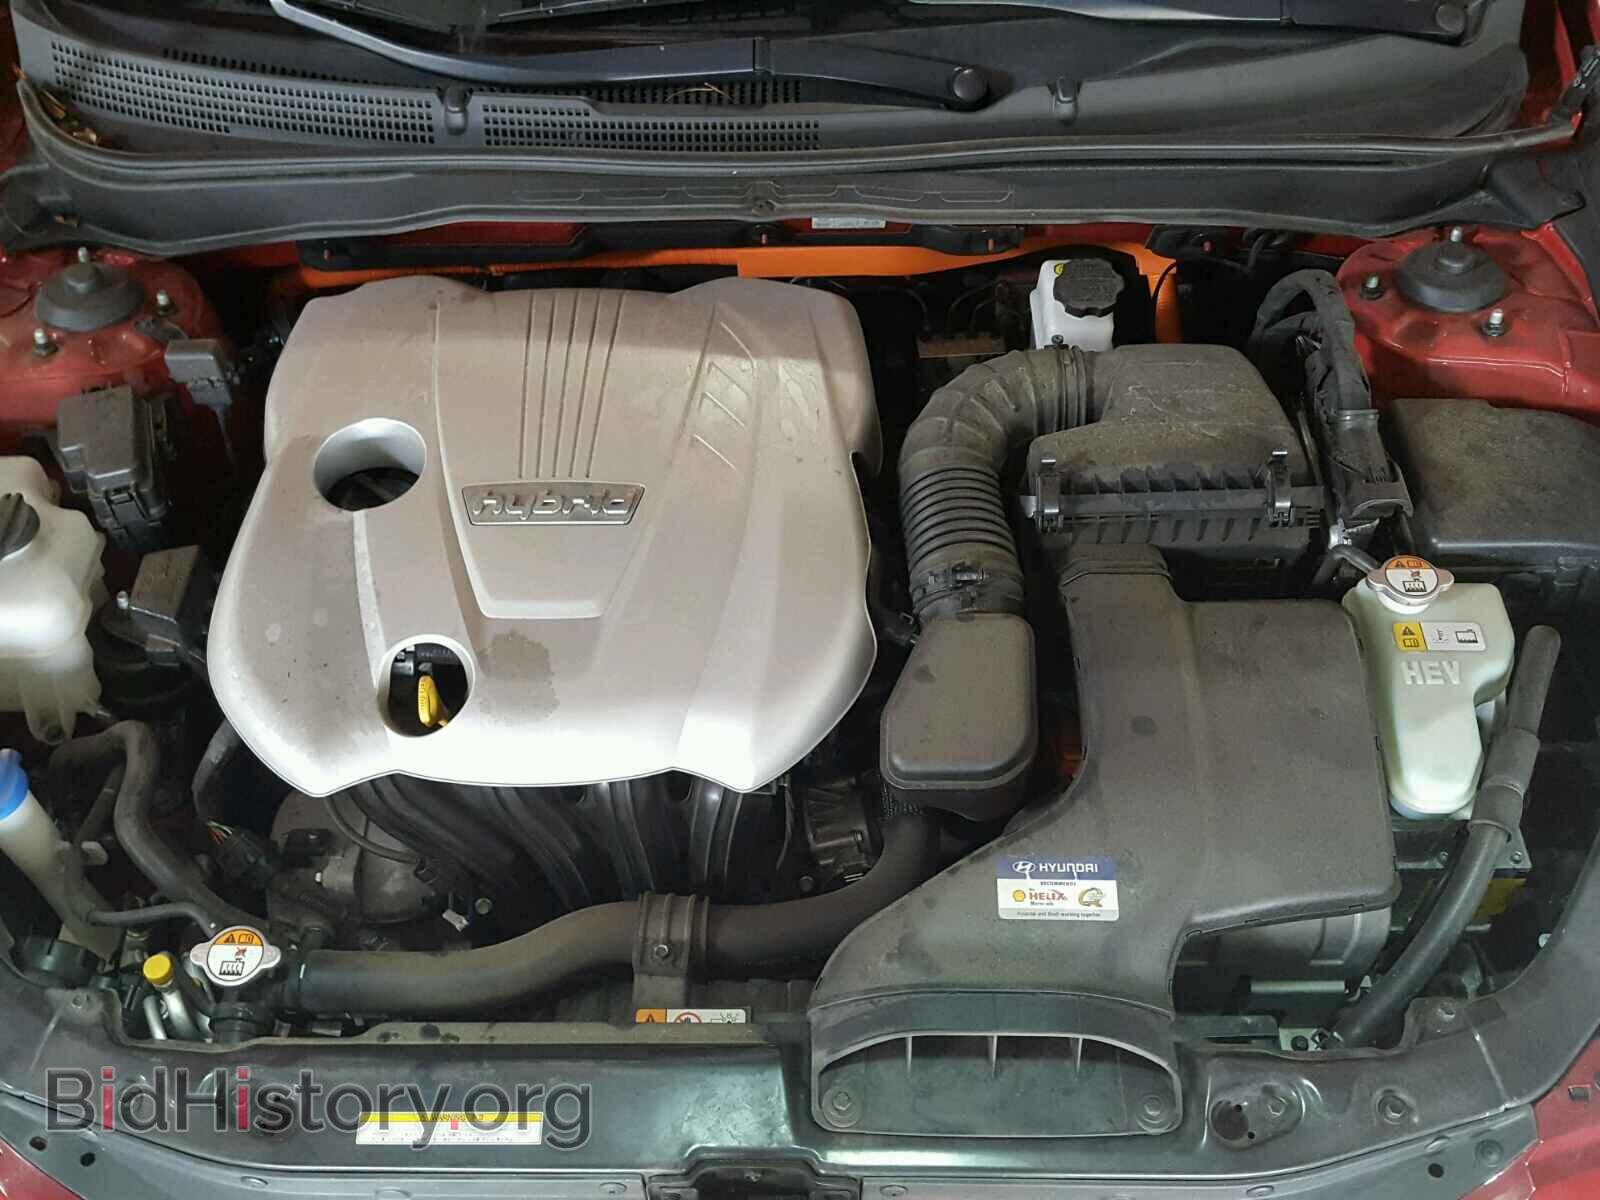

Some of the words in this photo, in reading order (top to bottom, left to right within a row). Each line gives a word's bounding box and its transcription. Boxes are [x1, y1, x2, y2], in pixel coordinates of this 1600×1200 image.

[1400, 660, 1461, 685] HEV
[1039, 863, 1099, 873] HYUNDAI
[1029, 891, 1065, 901] HELIX
